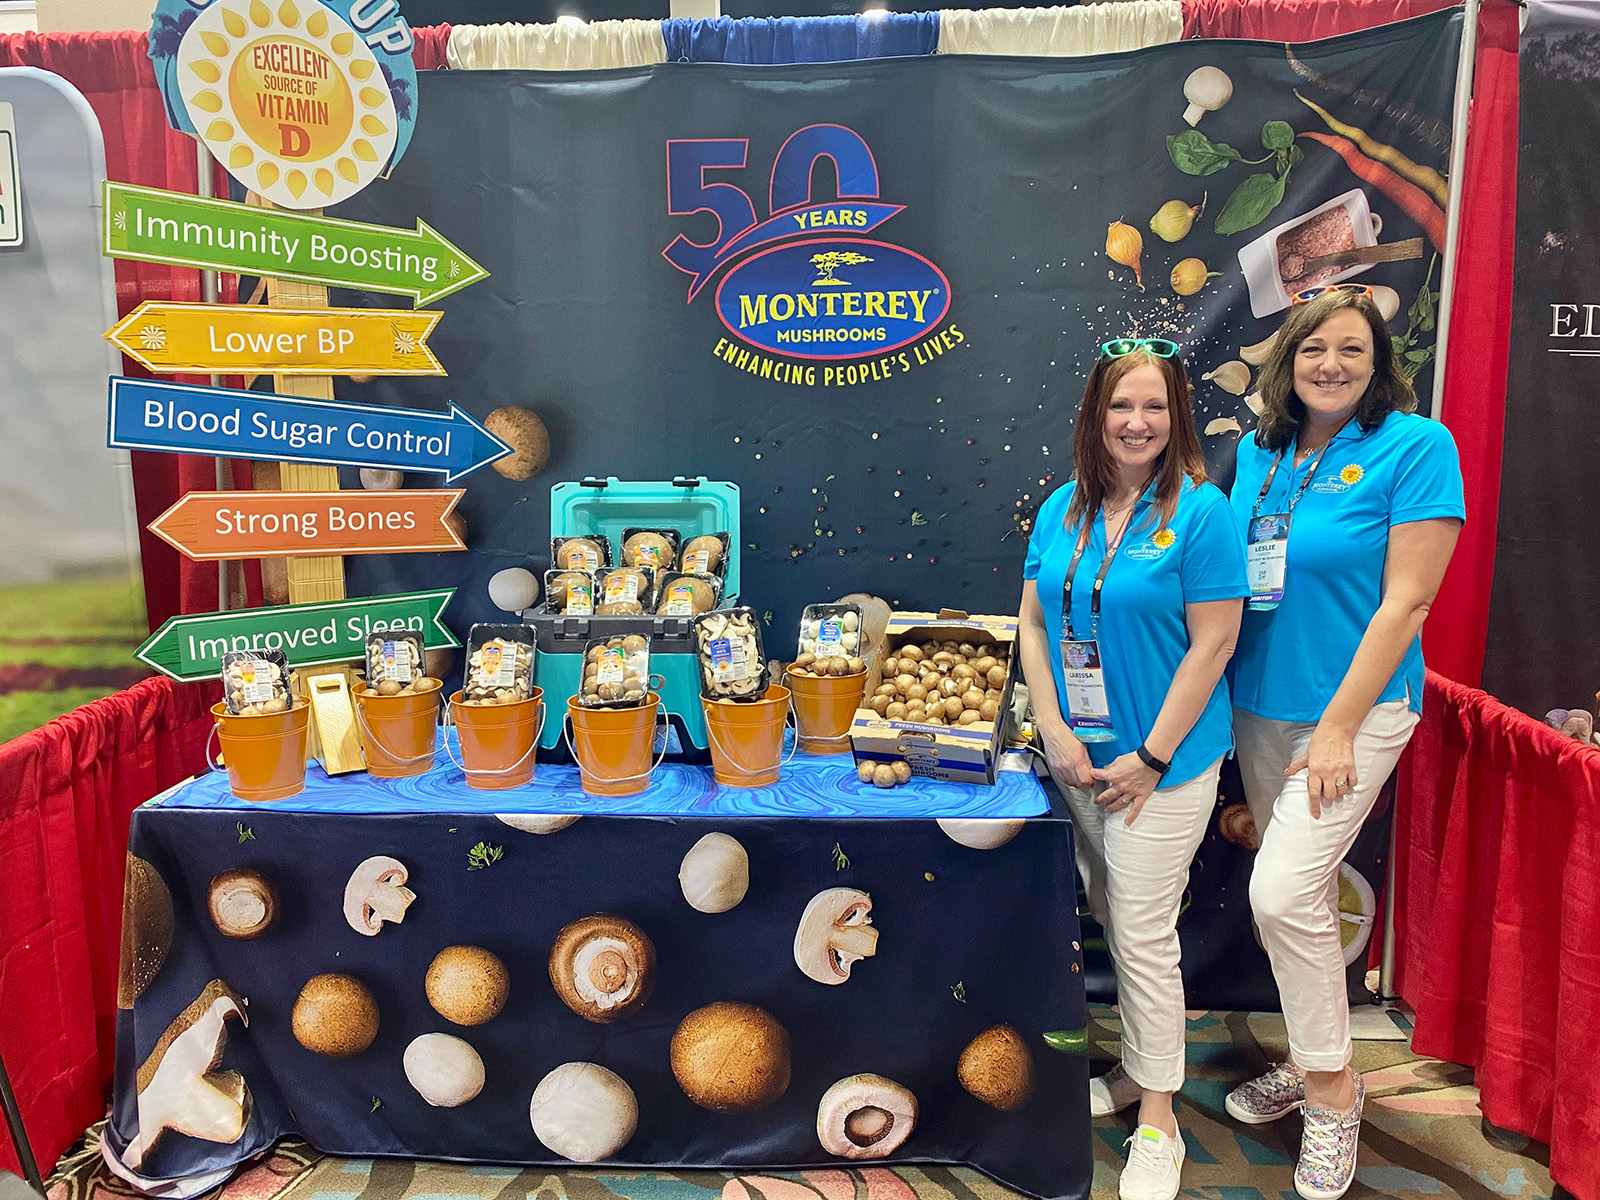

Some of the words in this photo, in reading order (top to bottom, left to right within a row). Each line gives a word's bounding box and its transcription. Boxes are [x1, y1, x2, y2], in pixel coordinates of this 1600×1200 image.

[350, 0, 411, 55] UP
[253, 44, 329, 80] EXCELLENT
[264, 74, 303, 94] SOURCE
[305, 81, 317, 96] OF
[256, 92, 329, 126] VITAMIN
[278, 123, 311, 157] D
[662, 123, 880, 282] 50
[793, 210, 867, 230] YEARS
[135, 207, 300, 264] Immunity
[311, 235, 439, 282] Boosting
[208, 324, 308, 354] Lower
[318, 328, 355, 354] BP
[776, 327, 887, 344] MUSHROOMS
[713, 337, 816, 386] ENHANCING
[824, 352, 911, 387] PEOPLE'S
[913, 323, 965, 366] LIVES
[143, 399, 241, 436] Blood
[251, 412, 338, 447] Sugar
[346, 422, 452, 456] Control
[215, 508, 318, 538] Strong
[328, 506, 416, 532] Bones
[1255, 544, 1276, 553] LESLIE
[188, 618, 338, 661] Improved
[894, 722, 913, 730] FRESH
[914, 725, 951, 733] MUSHROOMS
